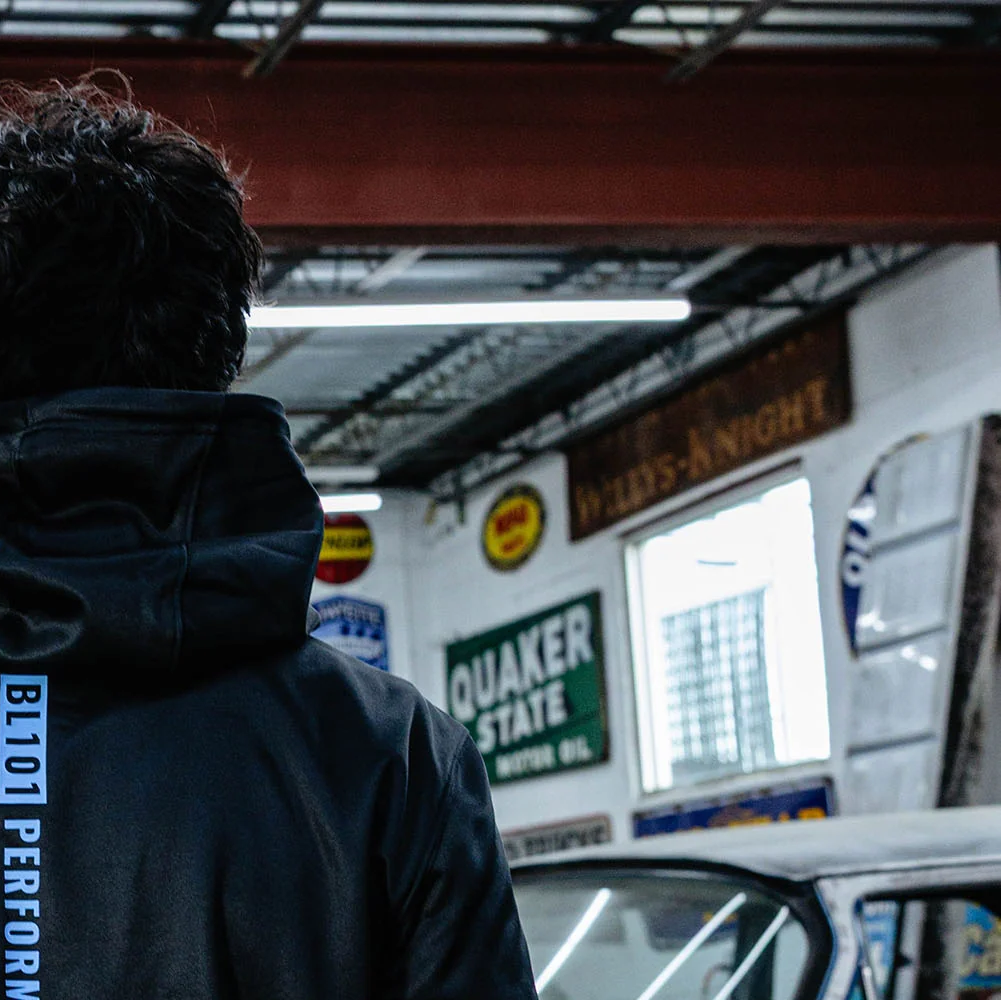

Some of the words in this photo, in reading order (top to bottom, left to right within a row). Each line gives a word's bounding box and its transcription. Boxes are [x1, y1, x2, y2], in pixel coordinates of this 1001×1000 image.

[450, 604, 593, 722] QUAKER
[476, 679, 568, 753] STATE
[4, 683, 41, 796] BL101
